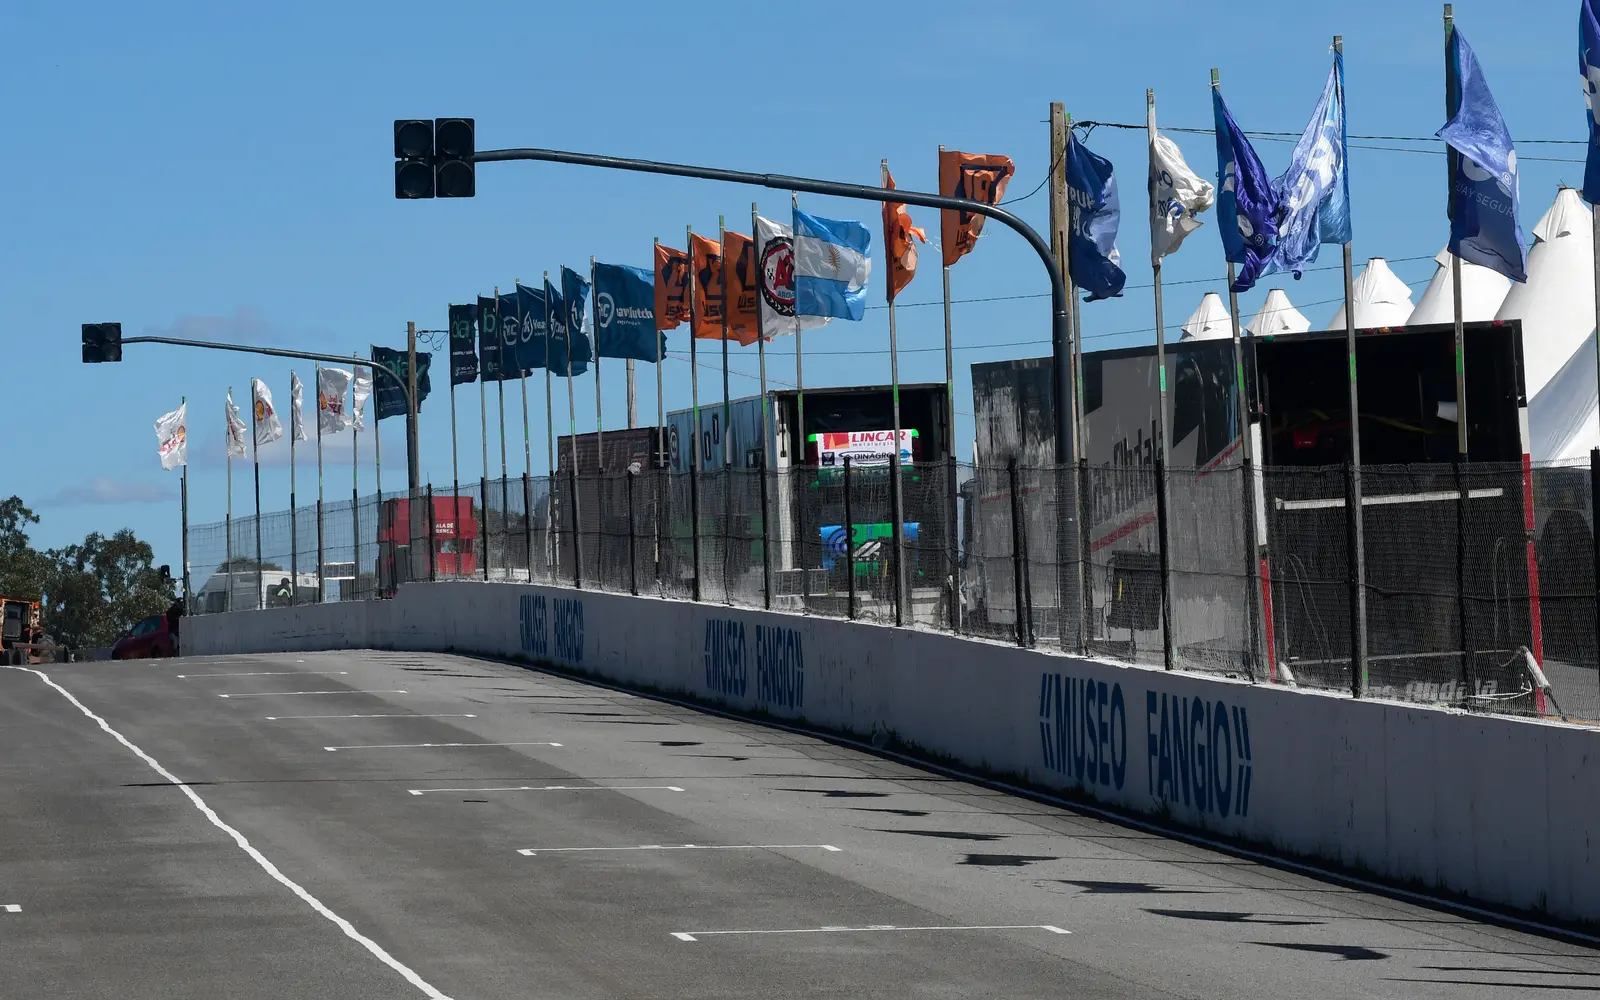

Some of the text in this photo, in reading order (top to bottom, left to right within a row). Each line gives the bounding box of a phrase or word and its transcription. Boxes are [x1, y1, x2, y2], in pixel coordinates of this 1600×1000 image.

[852, 431, 906, 442] LINCAR
[526, 594, 581, 662] MUSEO FANGIO
[711, 619, 795, 710] MUSEO FANGIO
[1054, 673, 1232, 818] MUSEO FANGIO
